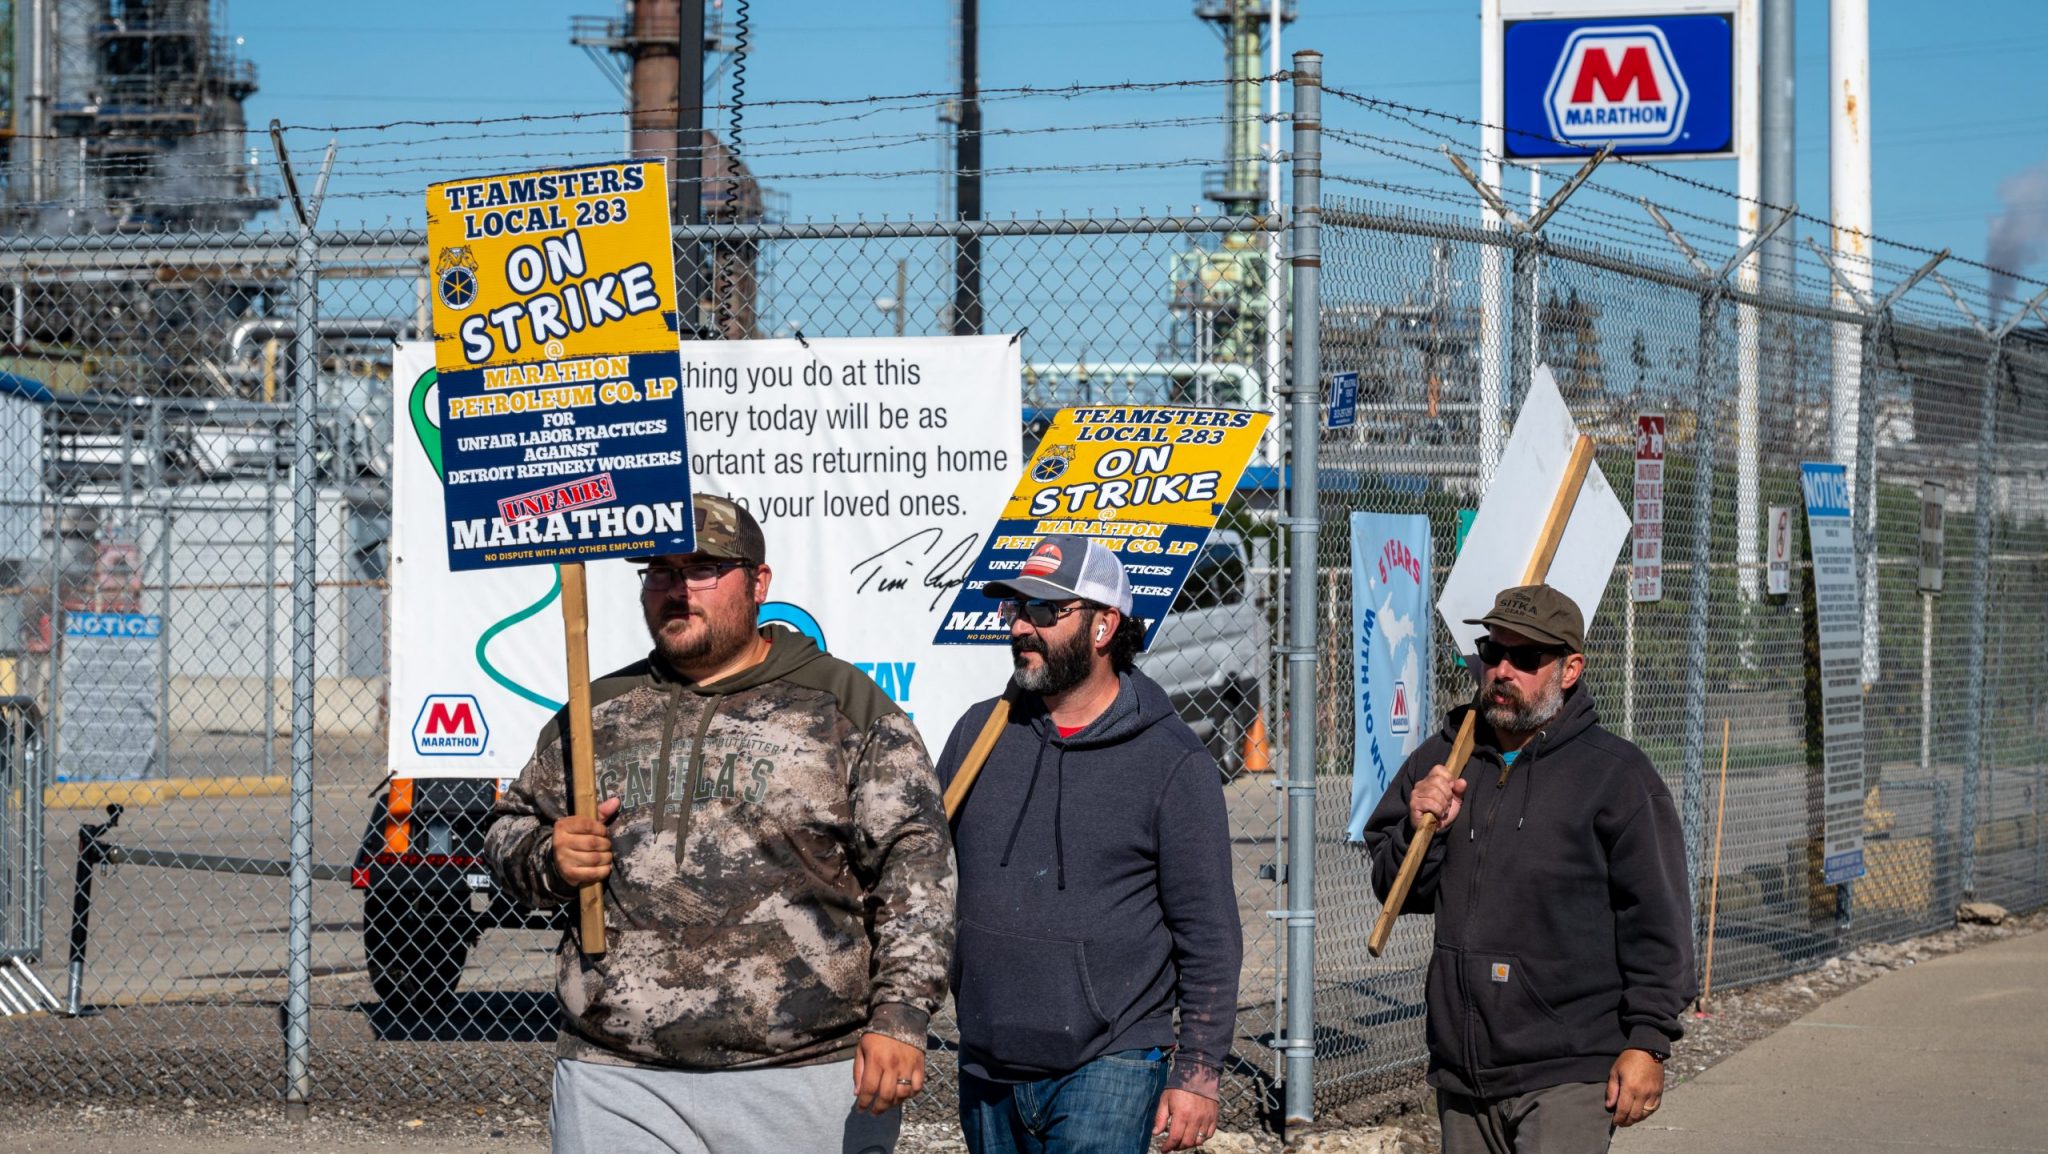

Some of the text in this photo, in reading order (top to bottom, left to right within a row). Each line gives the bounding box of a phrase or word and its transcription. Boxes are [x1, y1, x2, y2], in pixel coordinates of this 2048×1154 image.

[1571, 47, 1663, 103] M
[1565, 106, 1667, 125] MARATHON
[446, 165, 644, 212] TEAMSTERS
[465, 199, 627, 239] LOCAL 283
[505, 228, 587, 295] ON
[460, 262, 661, 363] STRIKE
[484, 356, 629, 390] MARATHON
[683, 358, 921, 394] hing you do at this
[449, 378, 677, 419] PETROLEUM CO. LP
[458, 420, 667, 451] UNFAIR LABOR PRACTICES
[543, 412, 575, 428] FOR
[686, 402, 948, 437] nery today will be as
[1073, 409, 1253, 428] TEAMSTERS
[524, 442, 599, 461] AGAINST
[1077, 427, 1225, 445] LOCAL 283
[449, 451, 681, 485] DETROIT REFINERY WORKERS
[692, 448, 766, 475] ortant
[775, 453, 803, 474] as
[812, 445, 927, 478] returning
[937, 445, 1008, 472] home
[1095, 443, 1174, 478] ON
[503, 478, 610, 521] UNFAIR!
[759, 494, 815, 523] your
[824, 490, 890, 517] loved
[900, 493, 966, 517] ones.
[1029, 471, 1221, 517] STRIKE
[1803, 471, 1849, 508] NOTICE
[452, 502, 684, 550] MARATHON
[1034, 521, 1168, 538] MARATHON
[500, 551, 533, 560] DISPUTE
[535, 549, 557, 557] WITH
[559, 547, 576, 555] ANY
[579, 545, 607, 554] OTHER
[609, 541, 655, 551] EMPLOYER
[1127, 539, 1163, 553] CO.
[1165, 541, 1198, 556] LP
[1384, 539, 1420, 584] YEARS
[988, 561, 1174, 576] UNFA CTICES
[1131, 585, 1174, 596] KERS
[1499, 600, 1537, 616] SITKA
[65, 617, 161, 634] NOTICE
[853, 662, 916, 702] AY
[1361, 608, 1390, 792] WITH NO WTL
[424, 703, 477, 734] M
[421, 737, 479, 747] MARATHON
